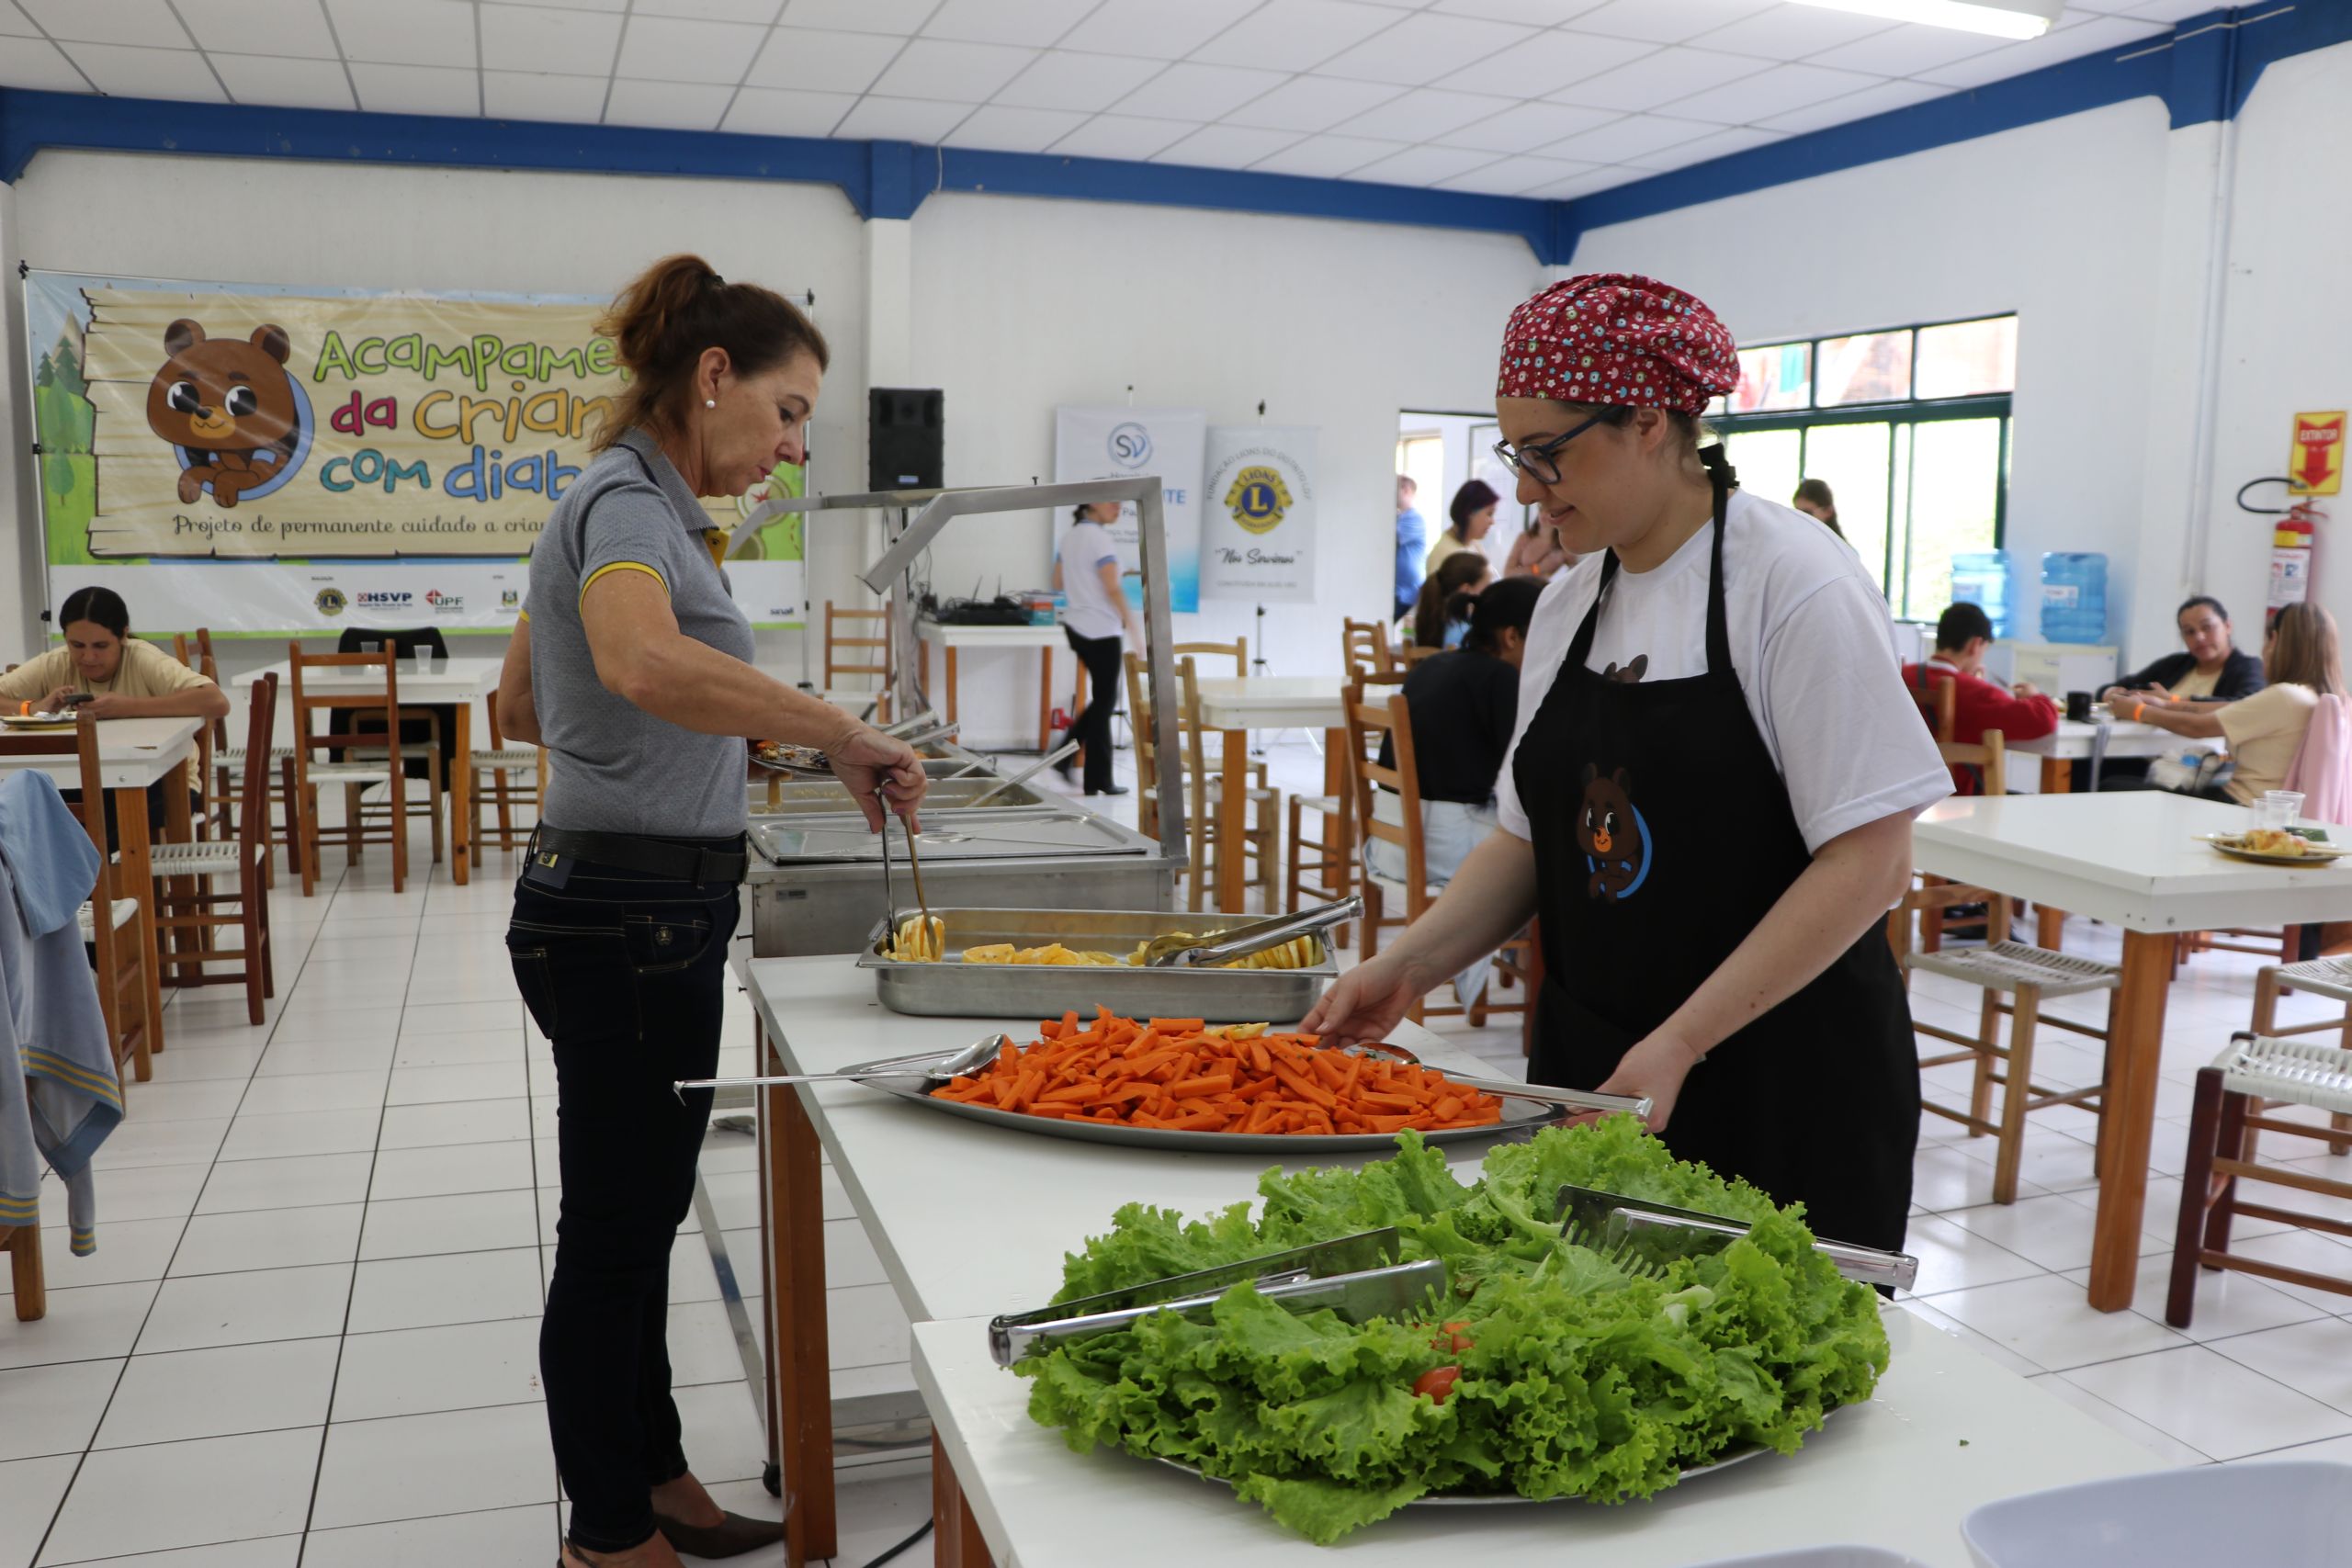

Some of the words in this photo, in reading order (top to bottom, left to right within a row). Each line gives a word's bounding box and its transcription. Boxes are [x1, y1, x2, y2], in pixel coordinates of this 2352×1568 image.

[313, 331, 630, 392] Acampame
[331, 389, 397, 436] da
[2300, 429, 2338, 442] EXTINTOR
[1242, 468, 1276, 482] LIONS
[1250, 486, 1268, 512] L
[173, 514, 243, 540] Projeto
[251, 514, 275, 533] de
[281, 518, 395, 540] permanente
[401, 514, 477, 533] cuidado
[484, 521, 498, 533] a
[368, 592, 413, 603] HSVP
[435, 596, 463, 606] UPF
